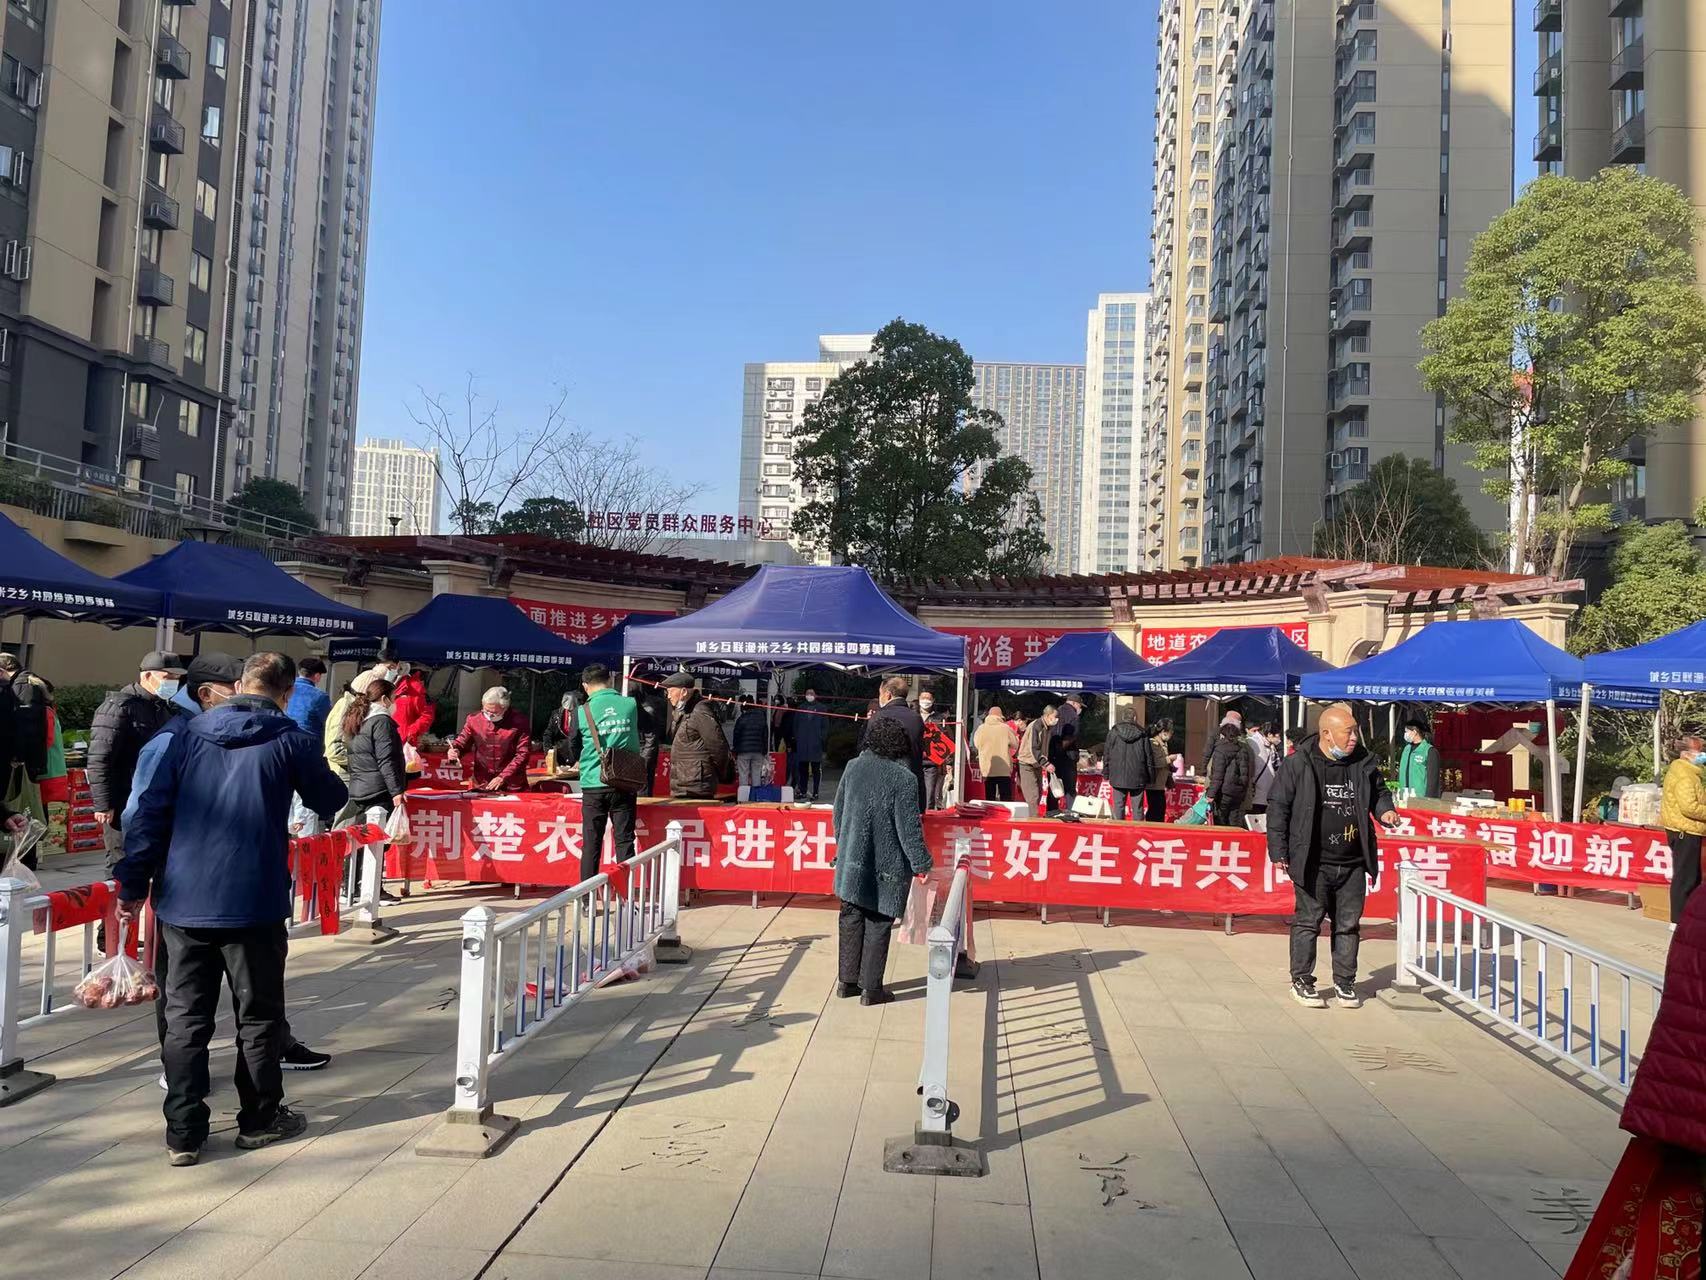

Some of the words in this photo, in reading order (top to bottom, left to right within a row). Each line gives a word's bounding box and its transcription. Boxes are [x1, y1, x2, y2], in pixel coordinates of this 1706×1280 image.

[588, 512, 773, 535] 社区党员群众服务中心
[695, 641, 793, 654] 城乡互联渔米之乡
[797, 641, 896, 656] 共同缔造四季美味
[1024, 635, 1060, 662] 共
[1650, 671, 1706, 684] 城乡互联渔
[411, 809, 836, 871] 荆楚农品进社
[942, 826, 1451, 896] 美好生活共造
